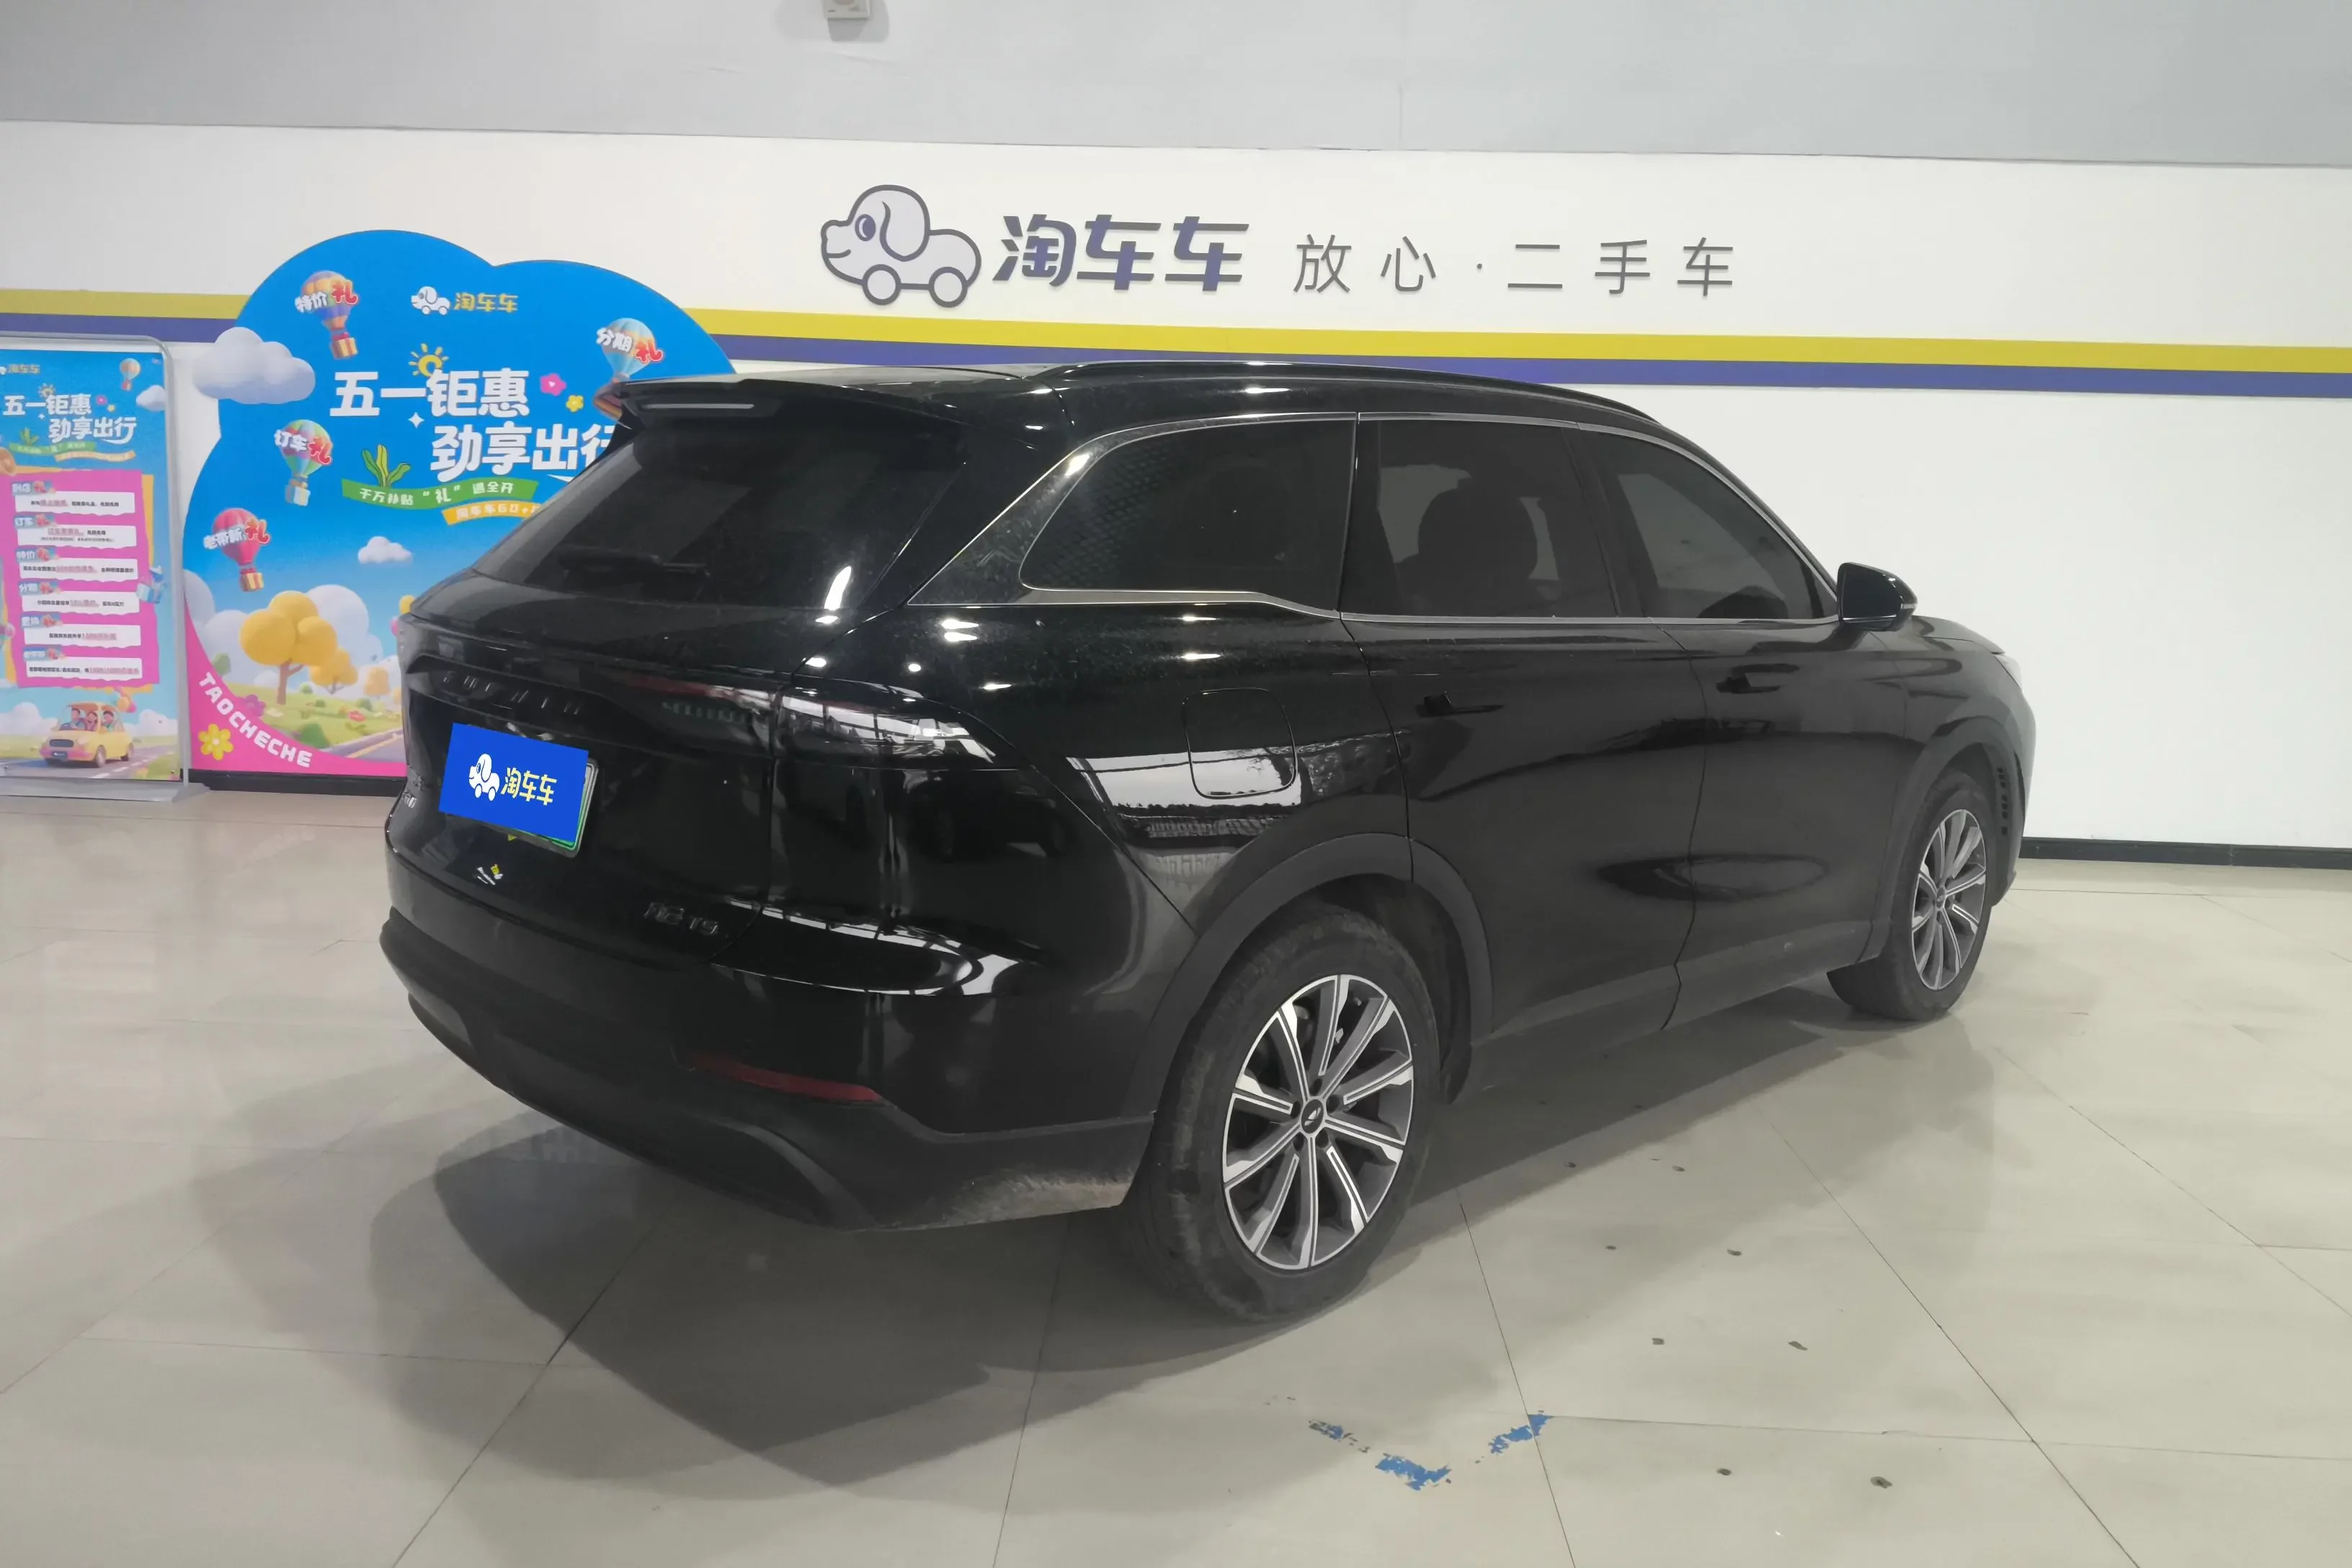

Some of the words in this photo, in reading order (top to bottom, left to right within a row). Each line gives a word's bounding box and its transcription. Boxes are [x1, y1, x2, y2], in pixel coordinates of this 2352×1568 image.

[992, 214, 1250, 291] 淘车车
[454, 292, 518, 313] 淘车车
[3, 393, 92, 416] 五一钜惠
[329, 368, 530, 417] 五一钜惠
[48, 416, 137, 445] 劲享出行
[199, 672, 313, 768] TAOCHECHE
